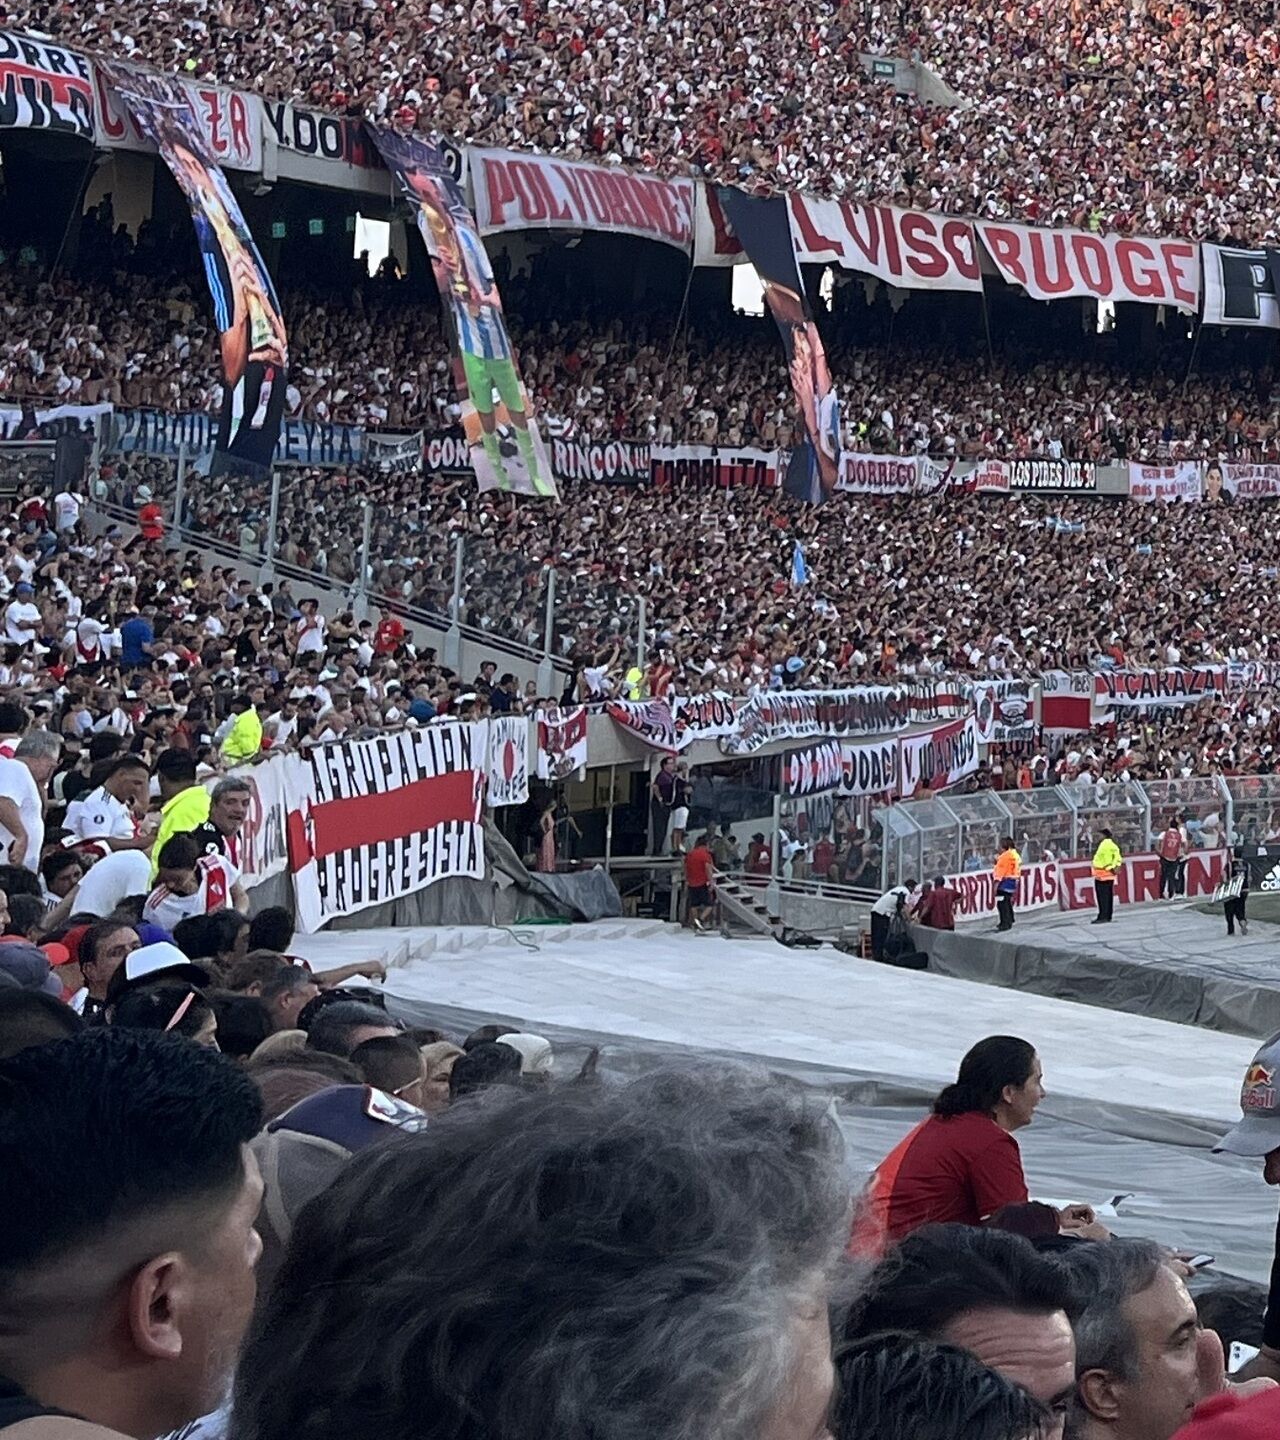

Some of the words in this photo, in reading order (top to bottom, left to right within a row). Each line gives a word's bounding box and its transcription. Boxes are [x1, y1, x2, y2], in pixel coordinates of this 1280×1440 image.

[482, 158, 694, 242] POLVORINES
[841, 199, 980, 280] VISO
[994, 226, 1196, 304] BUDGE
[845, 458, 917, 488] DORREGO
[1010, 461, 1031, 487] LOS
[1031, 461, 1063, 487] PIBES
[1063, 462, 1084, 487] DEL
[311, 721, 472, 803] AGRUPACION
[316, 820, 478, 917] PROGRESISTA
